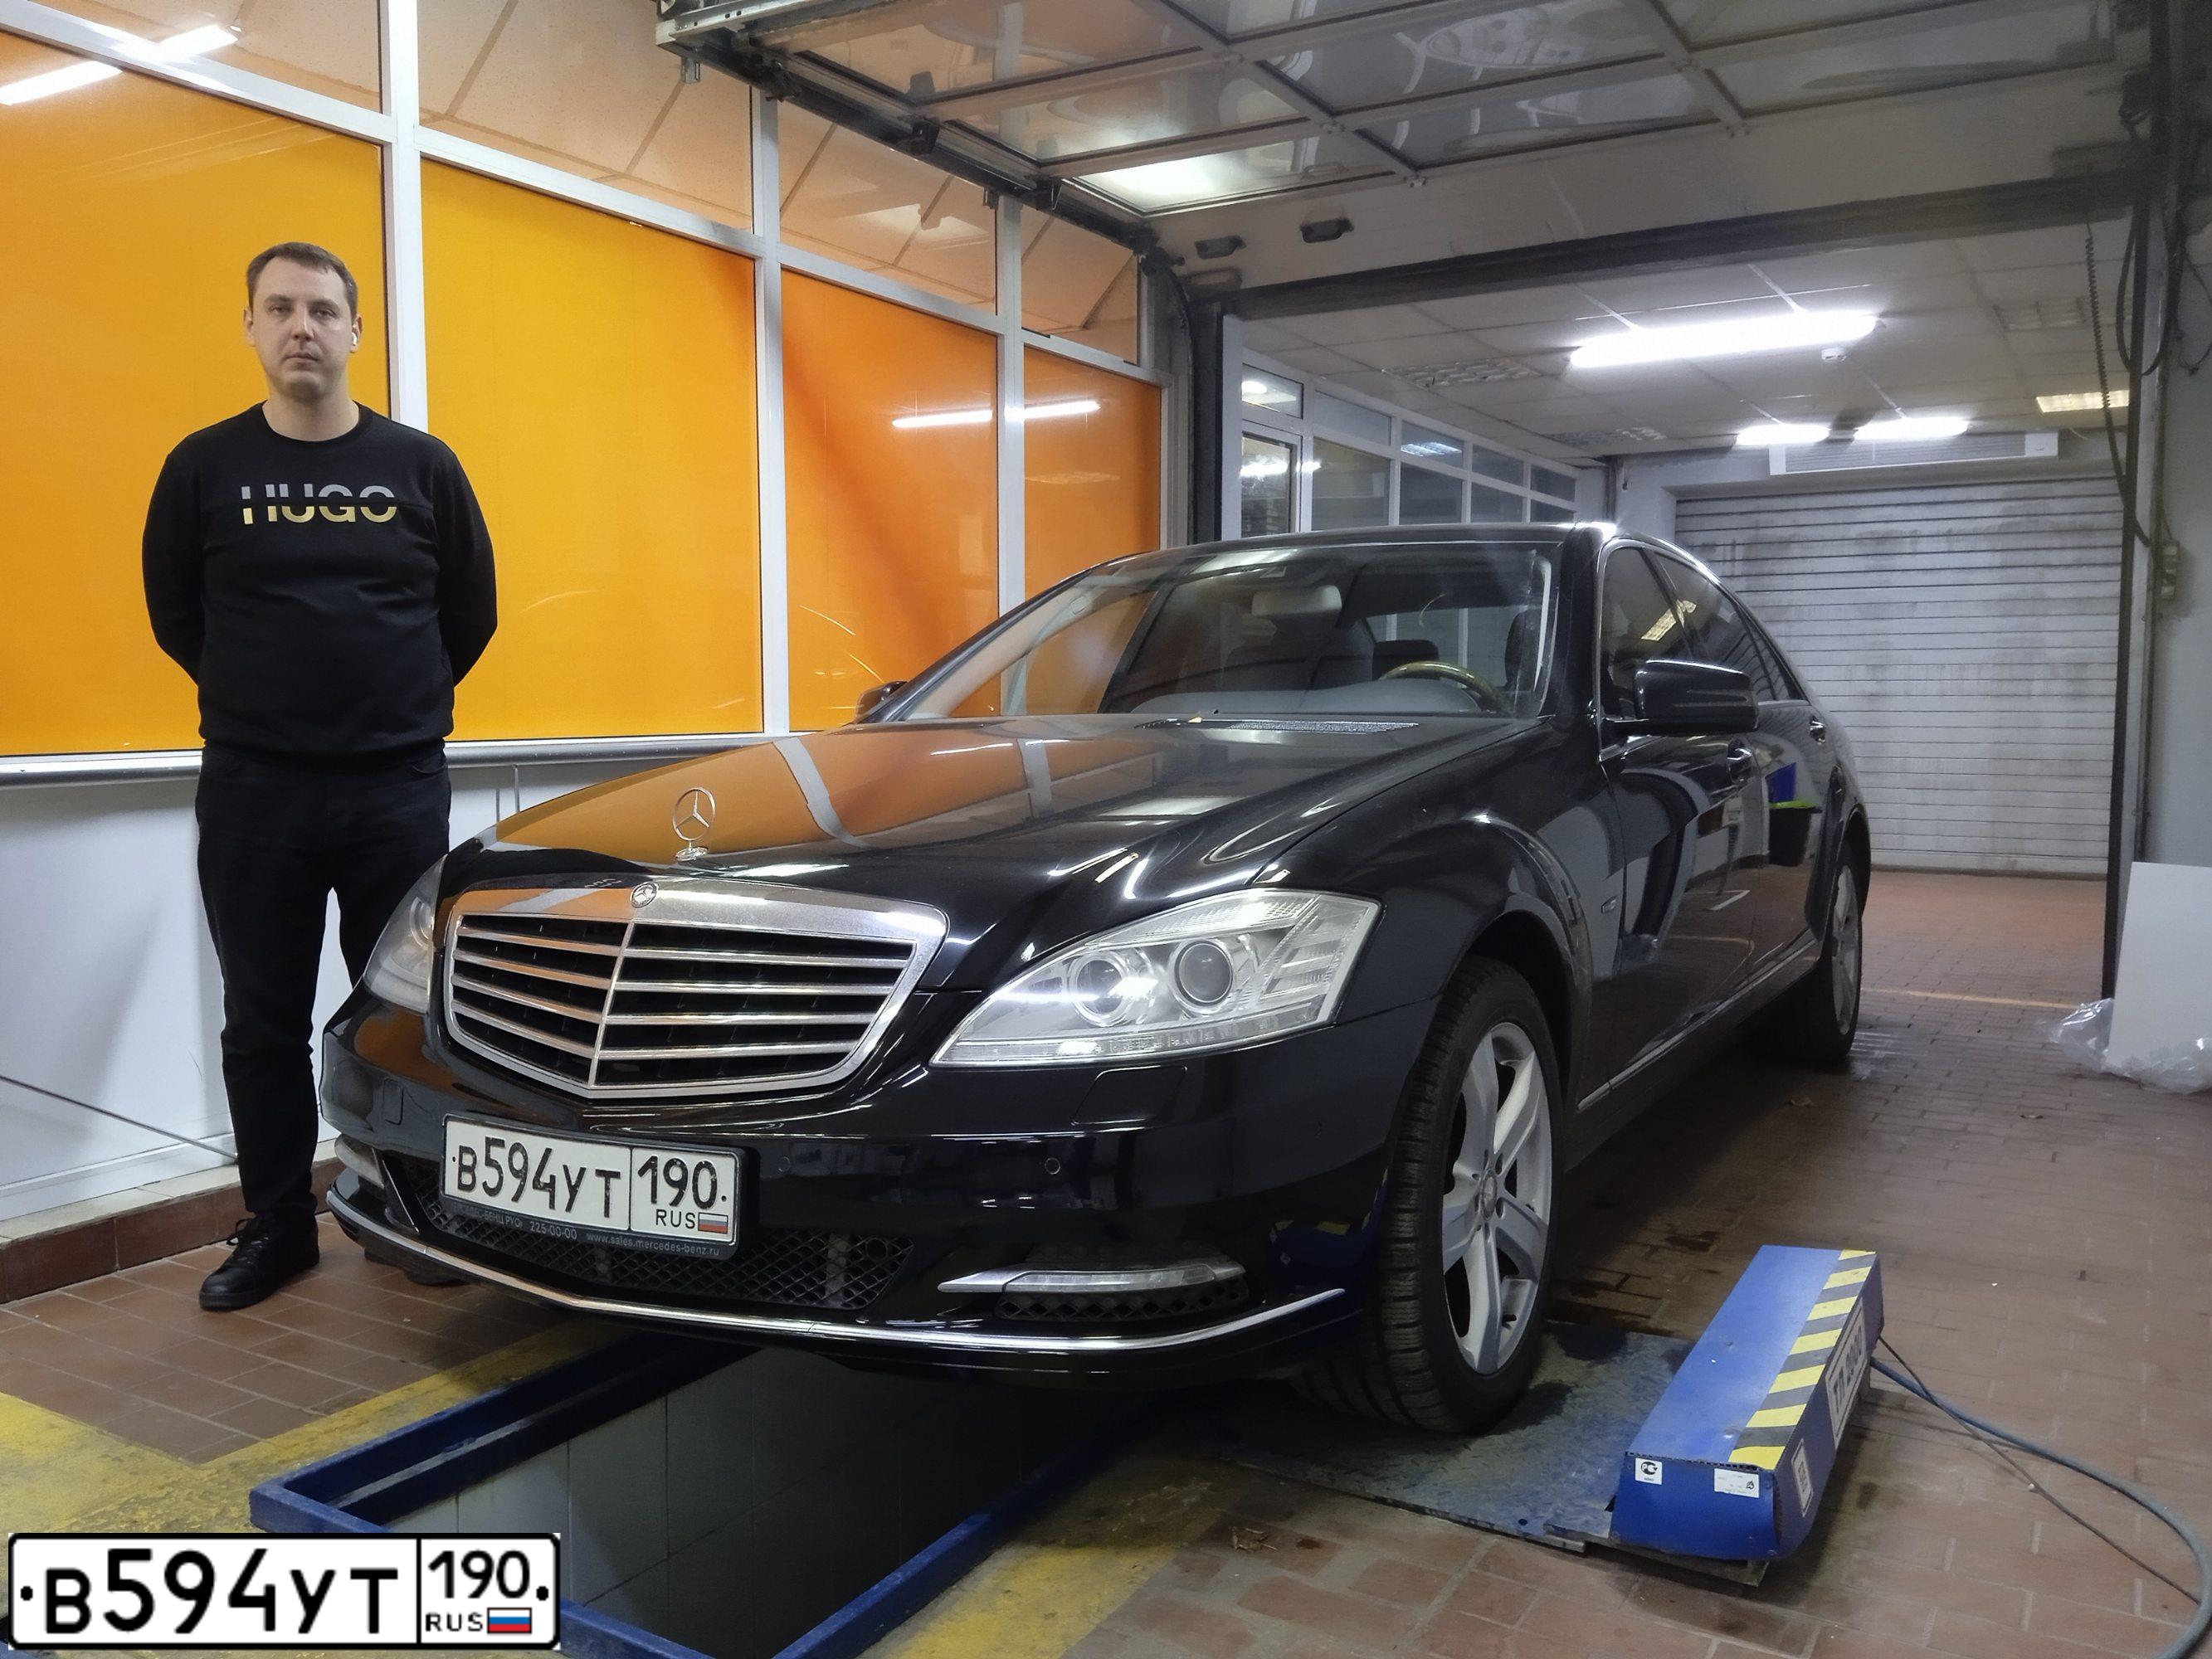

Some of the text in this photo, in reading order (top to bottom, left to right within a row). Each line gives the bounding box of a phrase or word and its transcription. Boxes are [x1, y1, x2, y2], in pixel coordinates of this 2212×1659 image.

[241, 483, 397, 525] HUGO
[457, 1136, 719, 1219] В594УТ 190
[530, 1220, 577, 1240] 225-00-00
[655, 1209, 696, 1229] RUS
[586, 1233, 719, 1256] www.sales.mercedes-benz.ru
